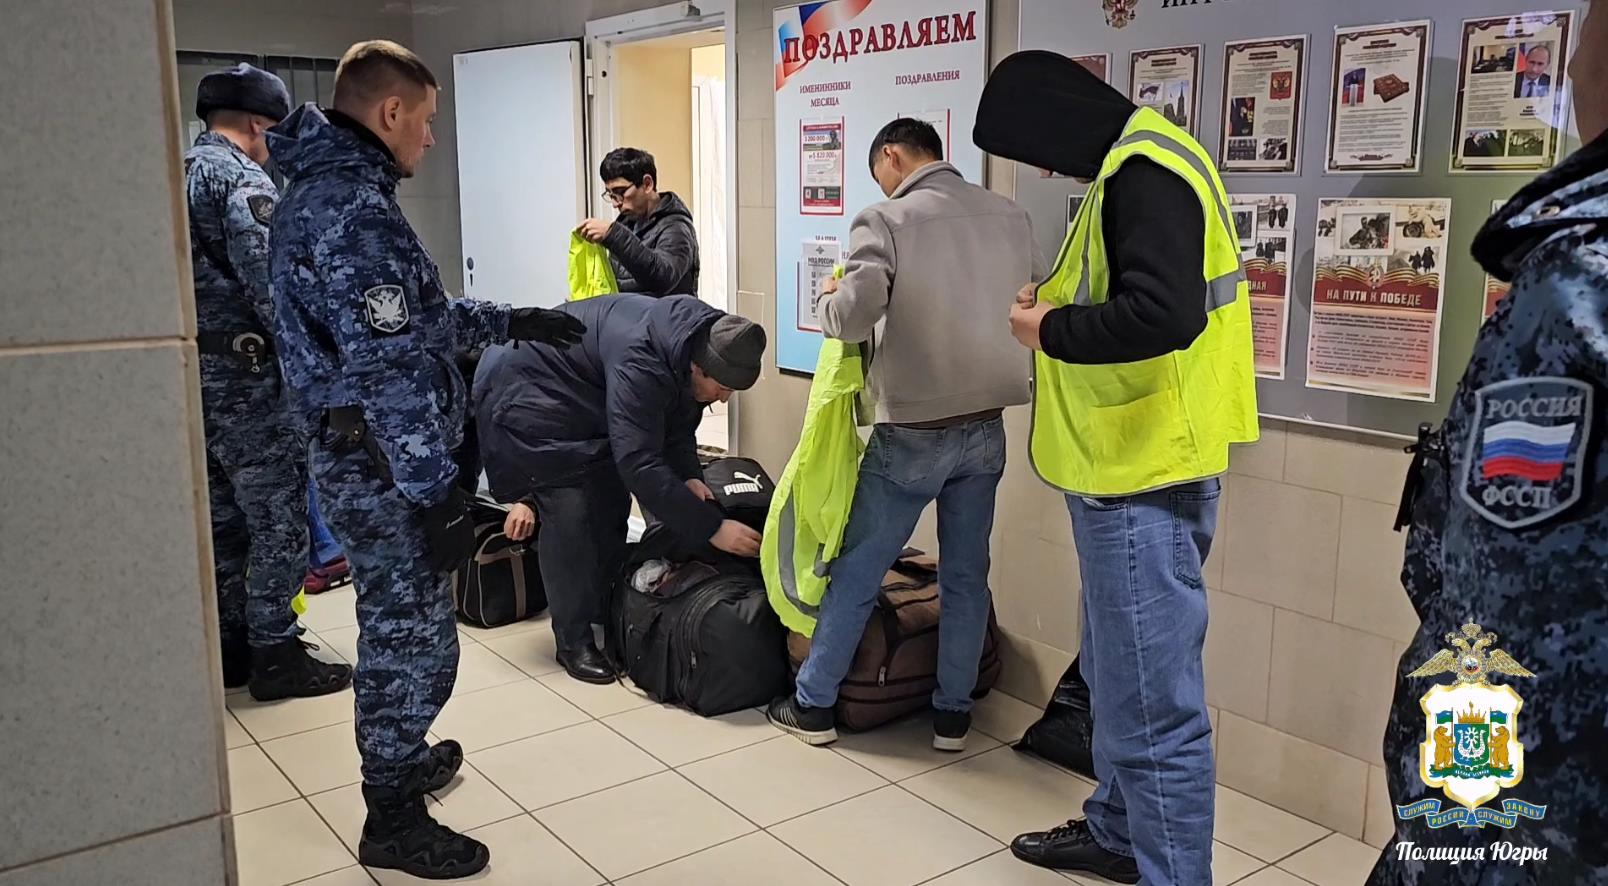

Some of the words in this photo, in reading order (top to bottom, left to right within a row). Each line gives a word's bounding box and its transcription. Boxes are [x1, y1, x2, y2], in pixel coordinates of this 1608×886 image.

[783, 11, 976, 64] ПОЗДРАВЛЯЕМ
[895, 70, 960, 85] ПОЗДРАВЛЕНИЯ
[799, 81, 851, 94] ИМЕНИННИКИ
[810, 97, 839, 108] МЕСЯЦА
[1326, 288, 1339, 300] НА
[1343, 289, 1367, 302] ПУТИ
[1370, 291, 1377, 303] К
[1380, 291, 1421, 307] ПОБЕДЕ
[1486, 396, 1584, 419] РОССИЯ
[723, 482, 759, 496] PUMA
[1482, 485, 1553, 509] ФССП
